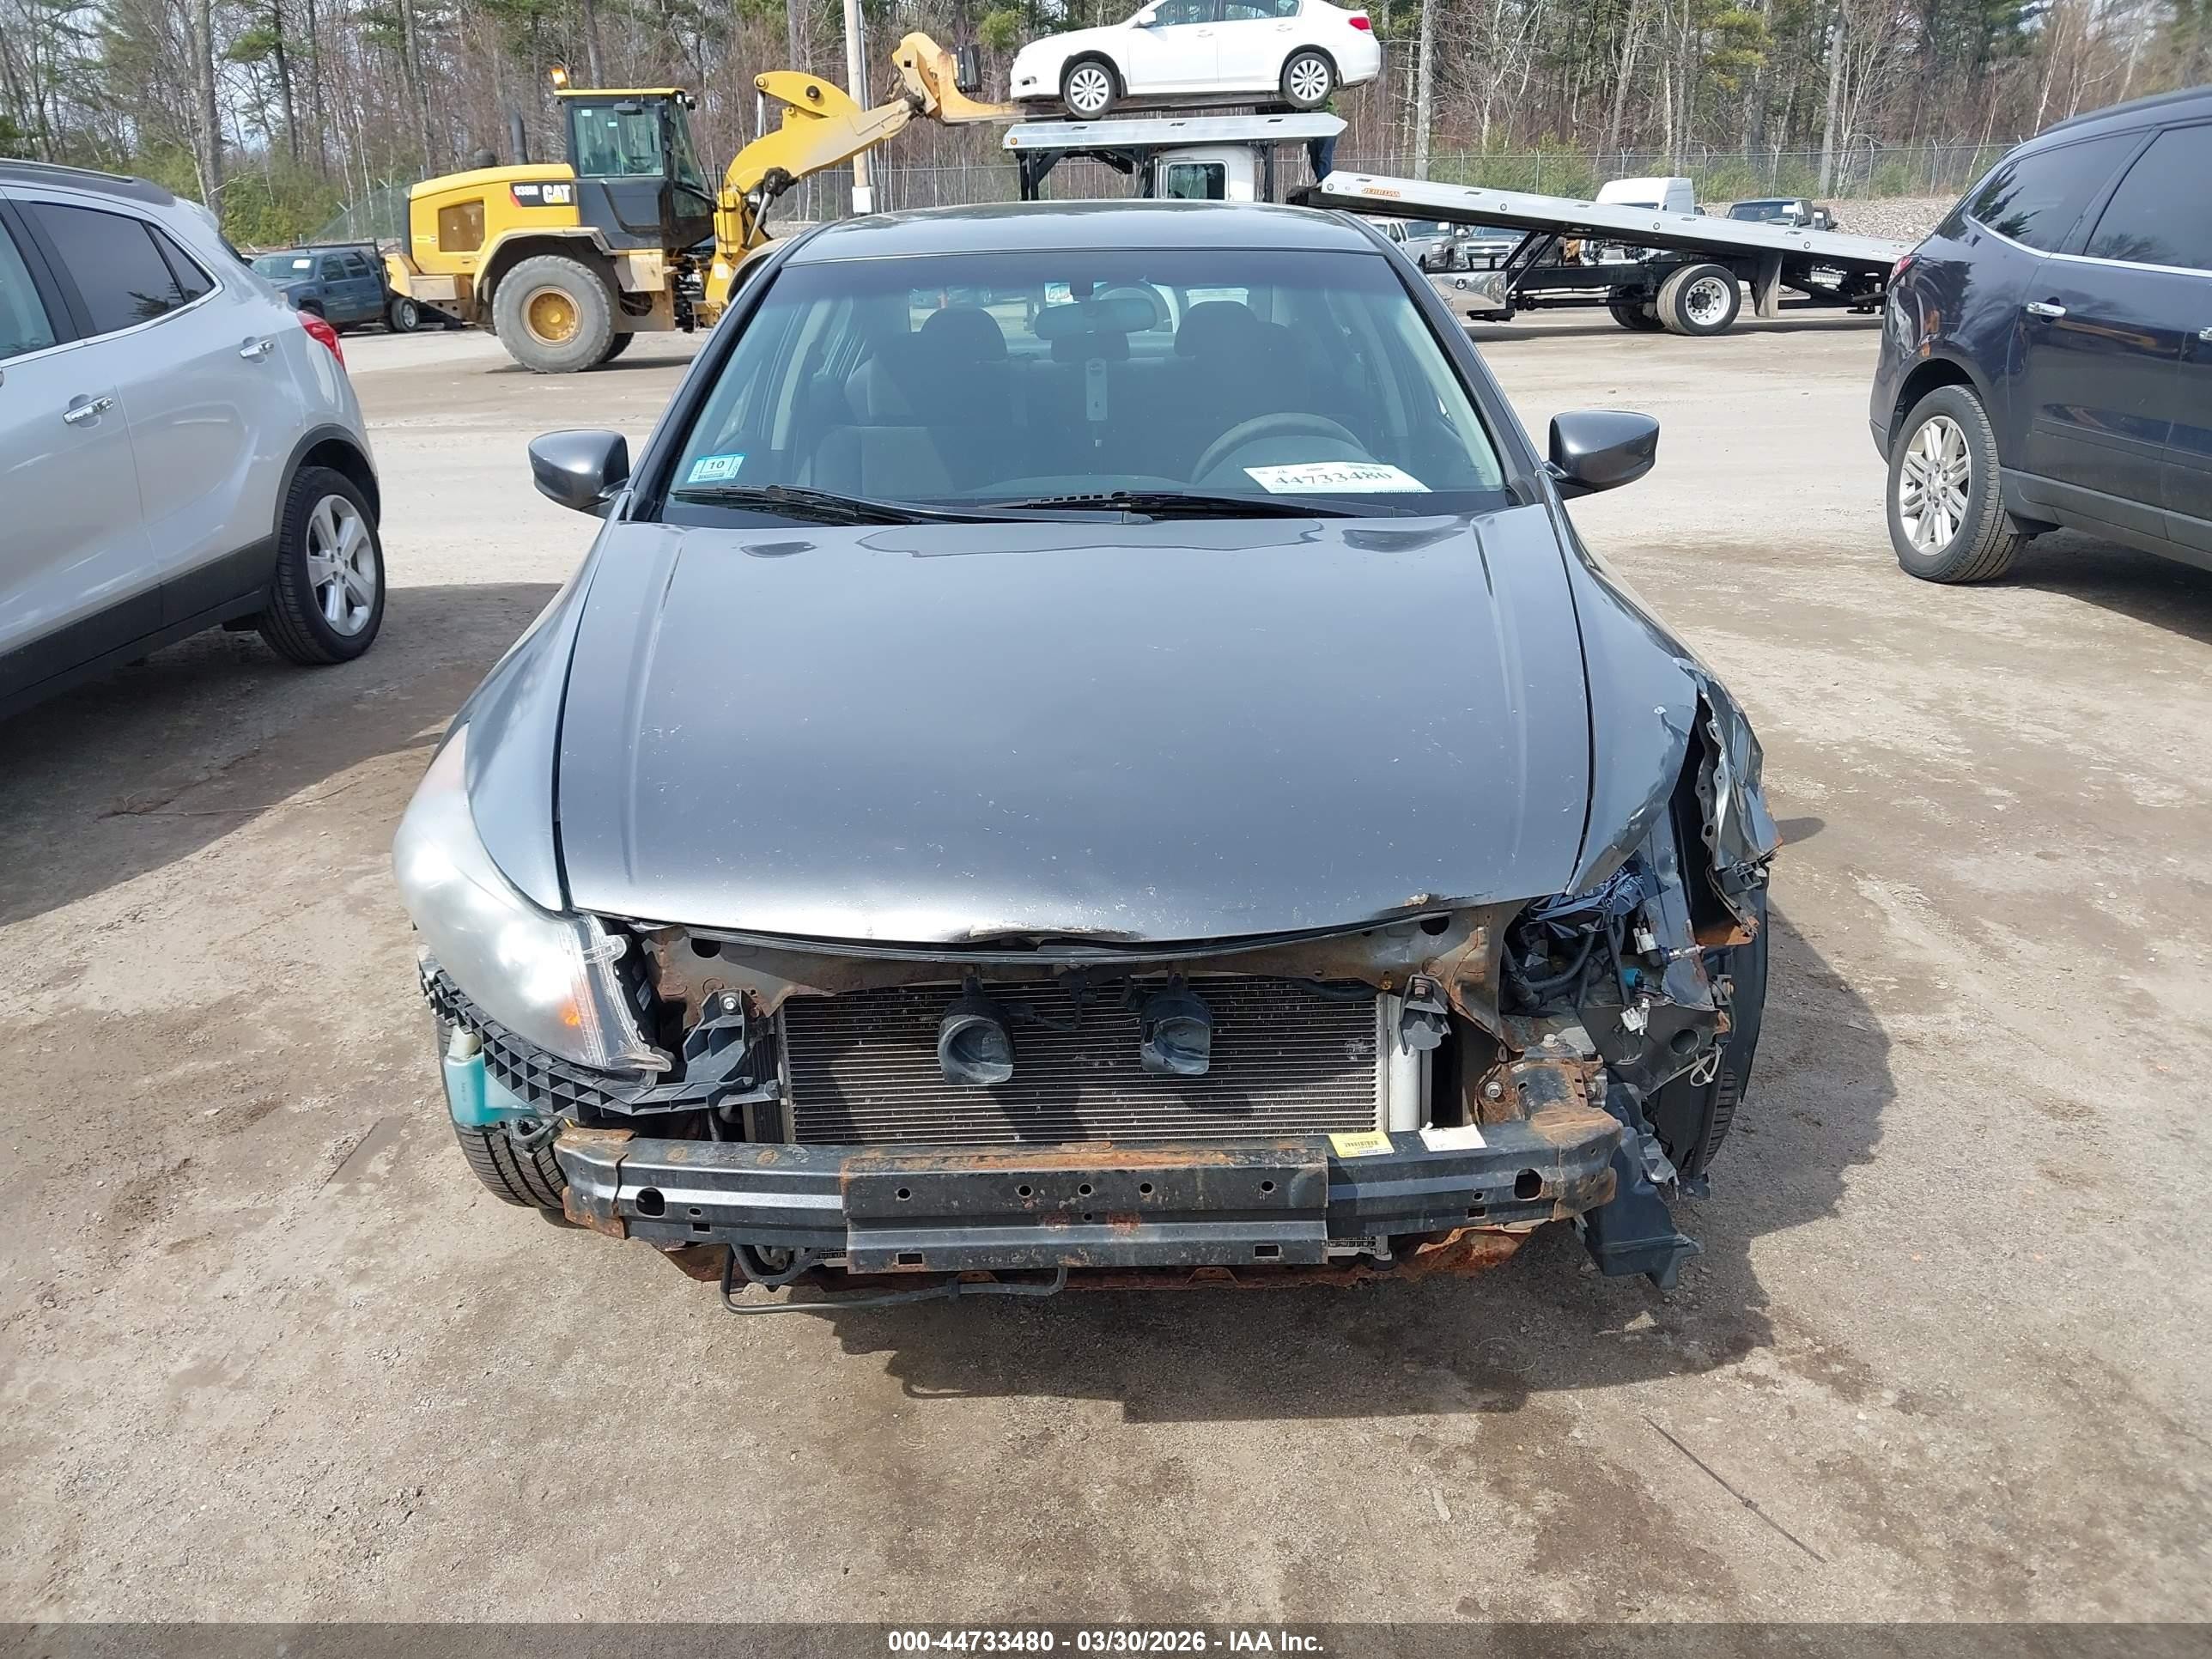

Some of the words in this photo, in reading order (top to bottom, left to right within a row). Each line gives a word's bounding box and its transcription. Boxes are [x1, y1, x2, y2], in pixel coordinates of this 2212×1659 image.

[542, 184, 571, 204] CAT
[708, 460, 725, 470] 10
[1274, 471, 1393, 484] 44733480
